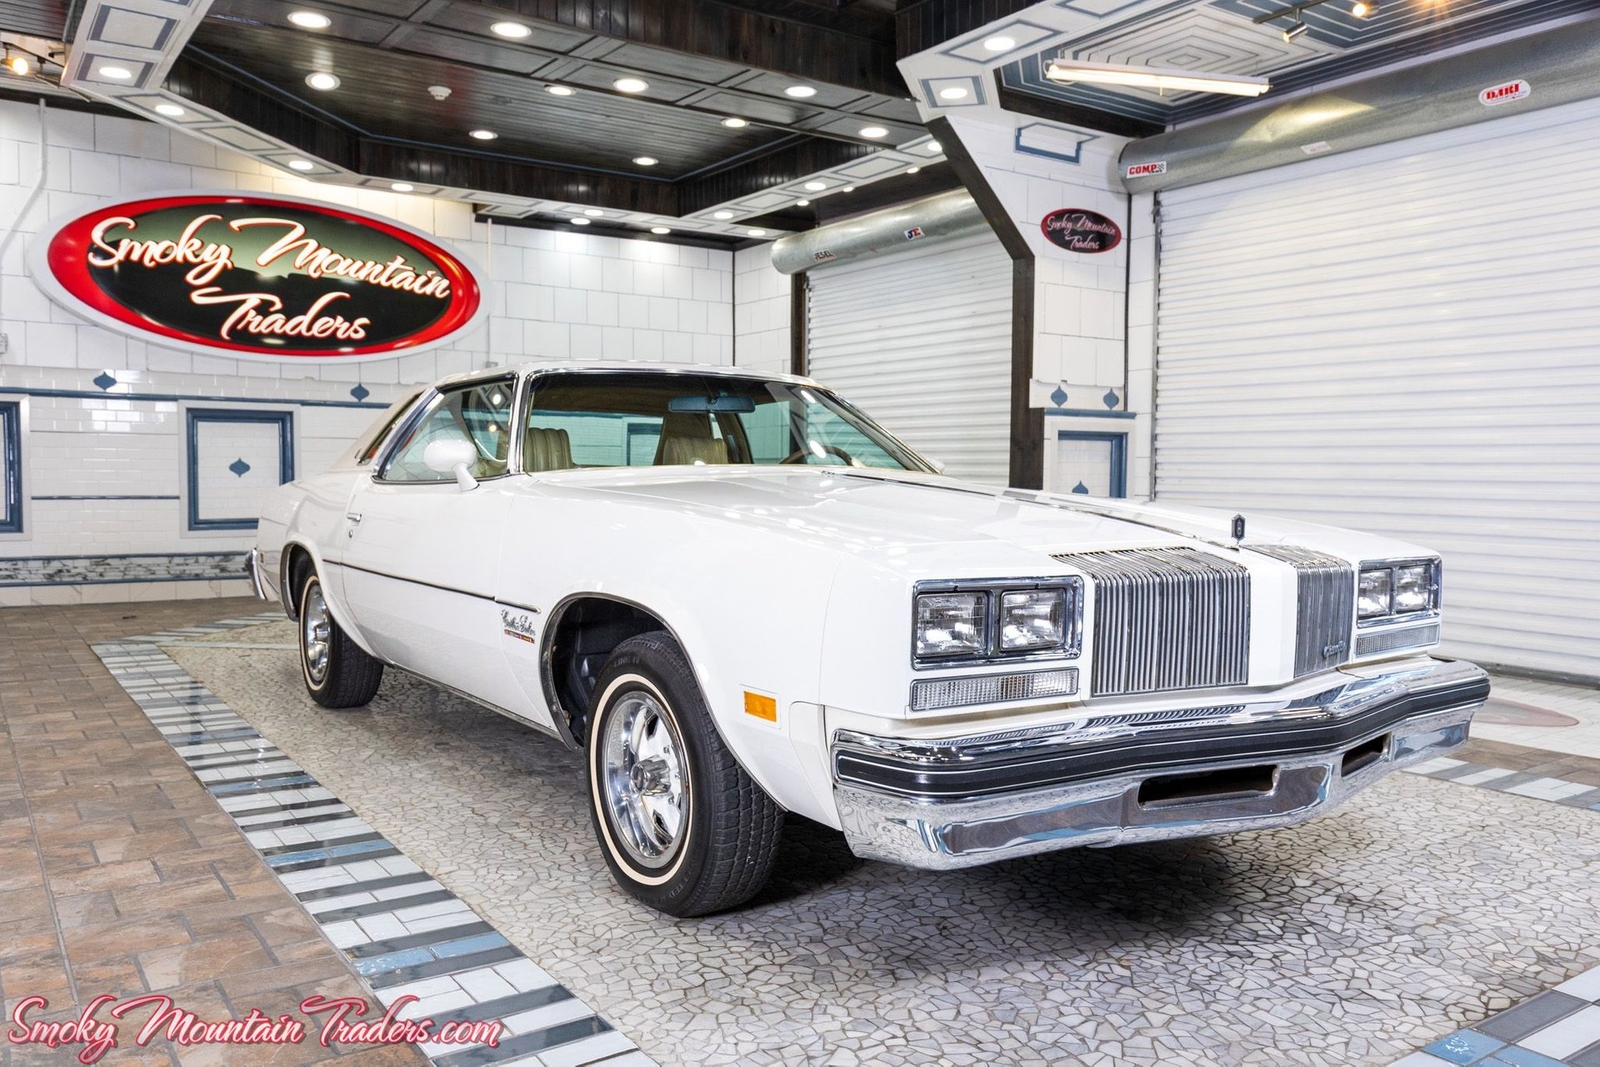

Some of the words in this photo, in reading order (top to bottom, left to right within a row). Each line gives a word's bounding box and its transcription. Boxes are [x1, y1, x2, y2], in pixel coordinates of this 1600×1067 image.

[1129, 163, 1158, 175] COMP
[1071, 213, 1116, 235] Mountain
[1064, 234, 1100, 250] Traders
[86, 213, 234, 286] Smoky
[228, 216, 454, 300] Mountain
[189, 286, 372, 341] Traders
